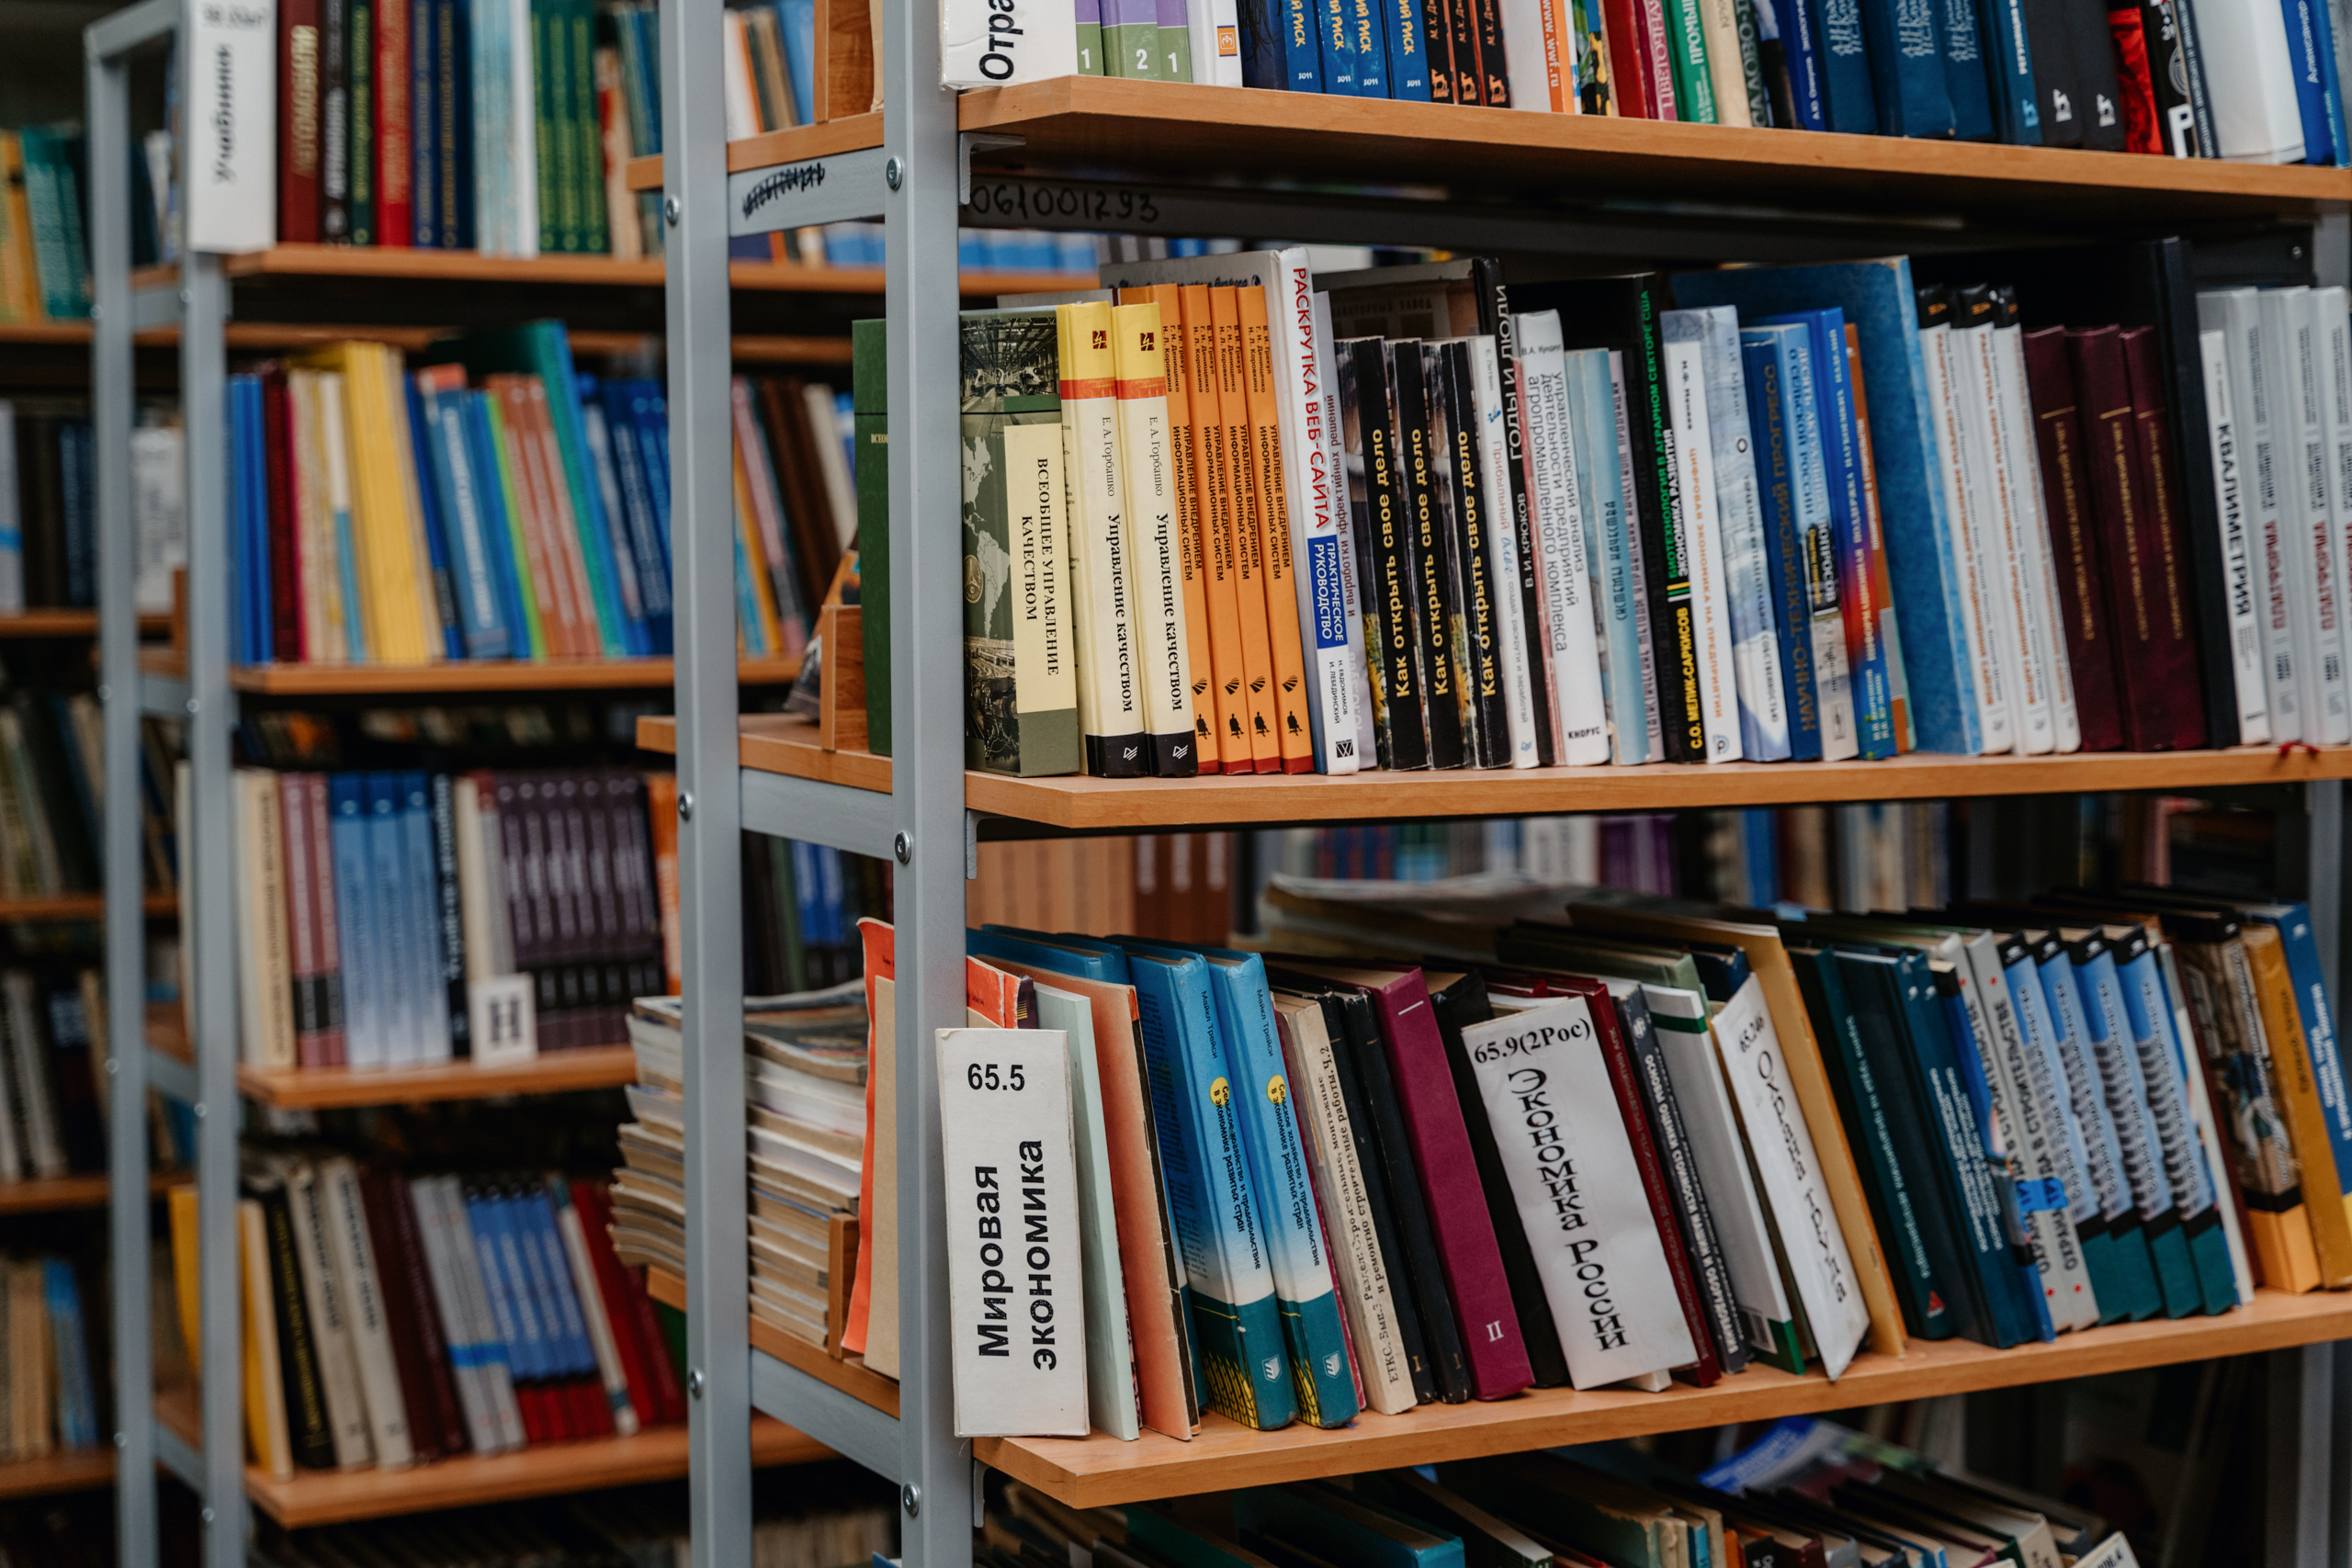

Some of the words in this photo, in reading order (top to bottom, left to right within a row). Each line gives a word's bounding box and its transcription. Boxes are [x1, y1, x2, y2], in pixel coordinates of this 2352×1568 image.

[1080, 49, 1091, 69] 1
[1136, 49, 1148, 70] 2
[1168, 52, 1178, 73] 1
[1292, 13, 1306, 47] РИСК
[1331, 16, 1345, 51] РИСК
[1358, 19, 1372, 54] РИСК
[1401, 20, 1415, 56] РИСК
[1298, 72, 1313, 80] 2011
[1363, 77, 1378, 85] 2011
[1407, 79, 1421, 87] 2011
[1496, 285, 1514, 360] ЛЮДИ
[1640, 289, 1652, 321] США
[1164, 346, 1172, 392] Коровкина
[1171, 345, 1180, 392] Денищенко
[1194, 346, 1204, 393] Коровкина
[1202, 345, 1210, 393] Денищенко
[1220, 346, 1228, 392] Коровкина
[1227, 345, 1237, 392] Денищенко
[1250, 346, 1259, 392] Коровкина
[1257, 345, 1266, 392] Денищенко
[1503, 367, 1516, 385] И
[1643, 323, 1658, 381] СЕКТОРЕ
[1293, 268, 1317, 396] РАСКРУТКА
[1306, 401, 1330, 529] ВЕБ-САЙТА
[1327, 395, 1342, 447] решений
[1649, 383, 1666, 453] АГРАРНОМ
[1764, 363, 1785, 477] ПРОГРЕСС
[1104, 442, 1115, 497] Горбашко
[1151, 442, 1163, 497] Горбашко
[1183, 425, 1196, 494] УПРАВЛЕНИЕ
[1213, 425, 1227, 495] УПРАВЛЕНИЕ
[1270, 424, 1283, 493] УПРАВЛЕНИЕ
[1373, 429, 1390, 487] дело
[1411, 429, 1428, 487] дело
[1458, 431, 1476, 489] дело
[1553, 371, 1577, 509] управленческий
[1569, 514, 1584, 573] анализ
[1663, 429, 1679, 497] РАЗВИТИЯ
[1791, 365, 1808, 447] СЕЛЬСКОЙ
[1801, 452, 1815, 515] РОССИИ
[1037, 457, 1053, 555] ВСЕОБЩЕЕ
[1172, 426, 1189, 535] ИНФОРМАЦИОННЫХ
[1182, 537, 1193, 581] СИСТЕМ
[1204, 426, 1220, 536] ИНФОРМАЦИОННЫХ
[1213, 538, 1224, 581] СИСТЕМ
[1229, 425, 1246, 535] ИНФОРМАЦИОННЫХ
[1238, 537, 1250, 580] СИСТЕМ
[1240, 424, 1253, 495] УПРАВЛЕНИЕ
[1247, 498, 1260, 568] ВНЕДРЕНИЕМ
[1260, 425, 1276, 535] ИНФОРМАЦИОННЫХ
[1270, 536, 1281, 580] СИСТЕМ
[1331, 452, 1348, 536] эффективных
[1527, 376, 1556, 555] агропромышленного
[1546, 560, 1567, 652] комплекса
[1541, 373, 1564, 489] деятельности
[1555, 495, 1579, 607] предприятий
[1689, 448, 1703, 519] ЦИФРОВАЯ
[1189, 497, 1202, 570] ВНЕДРЕНИЕМ
[1219, 498, 1233, 570] ВНЕДРЕНИЕМ
[1276, 496, 1290, 568] ВНЕДРЕНИЕМ
[1380, 493, 1395, 548] свое
[1418, 493, 1432, 547] свое
[1464, 495, 1480, 549] свое
[1517, 492, 1532, 555] КРЮКОВ
[1604, 501, 1621, 560] КАЧЕСТВА
[1657, 469, 1679, 579] БИОТЕХНОЛОГИЯ
[1669, 497, 1689, 578] ЭКОНОМИКА
[2216, 423, 2251, 617] КВАЛИМЕТРИЯ
[1022, 515, 1037, 621] КАЧЕСТВОМ
[1314, 544, 1332, 640] РУКОВОДСТВО
[1327, 542, 1344, 641] ПРАКТИЧЕСКОЕ
[1340, 540, 1356, 605] выработки
[1492, 441, 1510, 530] Прибыльный
[1512, 619, 1522, 662] раскрути
[1517, 673, 1529, 724] заработай
[1523, 557, 1532, 572] И.
[1525, 573, 1534, 588] В.
[1610, 567, 1628, 621] СИСТЕМЫ
[1696, 524, 1712, 603] ЭКОНОМИКА
[1817, 517, 1837, 603] ВОПРОСОВ
[1041, 559, 1059, 676] УПРАВЛЕНИЕ
[1106, 513, 1126, 617] Управление
[1116, 624, 1133, 712] качеством
[1154, 513, 1175, 616] Управление
[1165, 622, 1183, 711] качеством
[1385, 555, 1405, 649] открыть
[1424, 554, 1443, 648] открыть
[1472, 555, 1491, 650] открыть
[1704, 604, 1713, 624] НА
[1772, 481, 1816, 730] НАУЧНО-ТЕХНИЧЕСКИЙ
[1330, 670, 1340, 725] ЛЕБЕДИНСКИЙ
[1339, 668, 1349, 716] ЕВДОКИМОВ
[1396, 655, 1410, 698] Как
[1434, 653, 1449, 696] Как
[1482, 655, 1497, 697] Как
[1676, 606, 1701, 721] МЕЛИК-САРКИСОВ
[1707, 627, 1723, 717] ПРЕДПРИЯТИИ
[1567, 727, 1600, 739] КНОРУС
[1688, 722, 1703, 750] С.О.
[1201, 990, 1212, 1022] Майкл
[1208, 1023, 1218, 1059] Трейси
[1256, 988, 1268, 1021] Майкл
[1264, 1022, 1274, 1057] Трейси
[1474, 1017, 1592, 1065] 65.9(2Рос)
[967, 1063, 1025, 1091] 65.5
[1327, 1067, 1346, 1122] работы.
[1992, 998, 2041, 1135] СТРОИТЕЛЬСТВЕ
[1317, 1075, 1339, 1150] монтажные
[2029, 1136, 2044, 1150] В
[1215, 1100, 1230, 1154] экономике
[1223, 1155, 1240, 1202] развитых
[1234, 1204, 1246, 1233] стран
[1222, 1085, 1235, 1130] Сельское
[1229, 1131, 1244, 1182] хозяйство
[1241, 1192, 1261, 1269] продовольствие
[1272, 1098, 1288, 1151] экономике
[1282, 1153, 1297, 1202] развитых
[1293, 1203, 1304, 1230] стран
[1277, 1083, 1291, 1127] Сельское
[1287, 1129, 1302, 1181] хозяйство
[1299, 1191, 1320, 1267] продовольствие
[1757, 1050, 1806, 1181] Охрана
[1804, 1187, 1847, 1303] труда
[1508, 1068, 1589, 1231] Экономика
[1565, 1239, 1631, 1352] России
[1644, 1054, 1665, 1103] ОСНОВЫ
[1657, 1103, 1679, 1149] ОЦЕНКИ
[1671, 1150, 1698, 1214] СТОИМОСТИ
[1690, 1215, 1710, 1256] МАШИН
[1704, 1268, 1739, 1354] ОБОРУДОВАНИЯ
[975, 1166, 1013, 1358] Мировая
[1019, 1140, 1057, 1371] экономика
[2050, 1209, 2079, 1270] ОХРАНА
